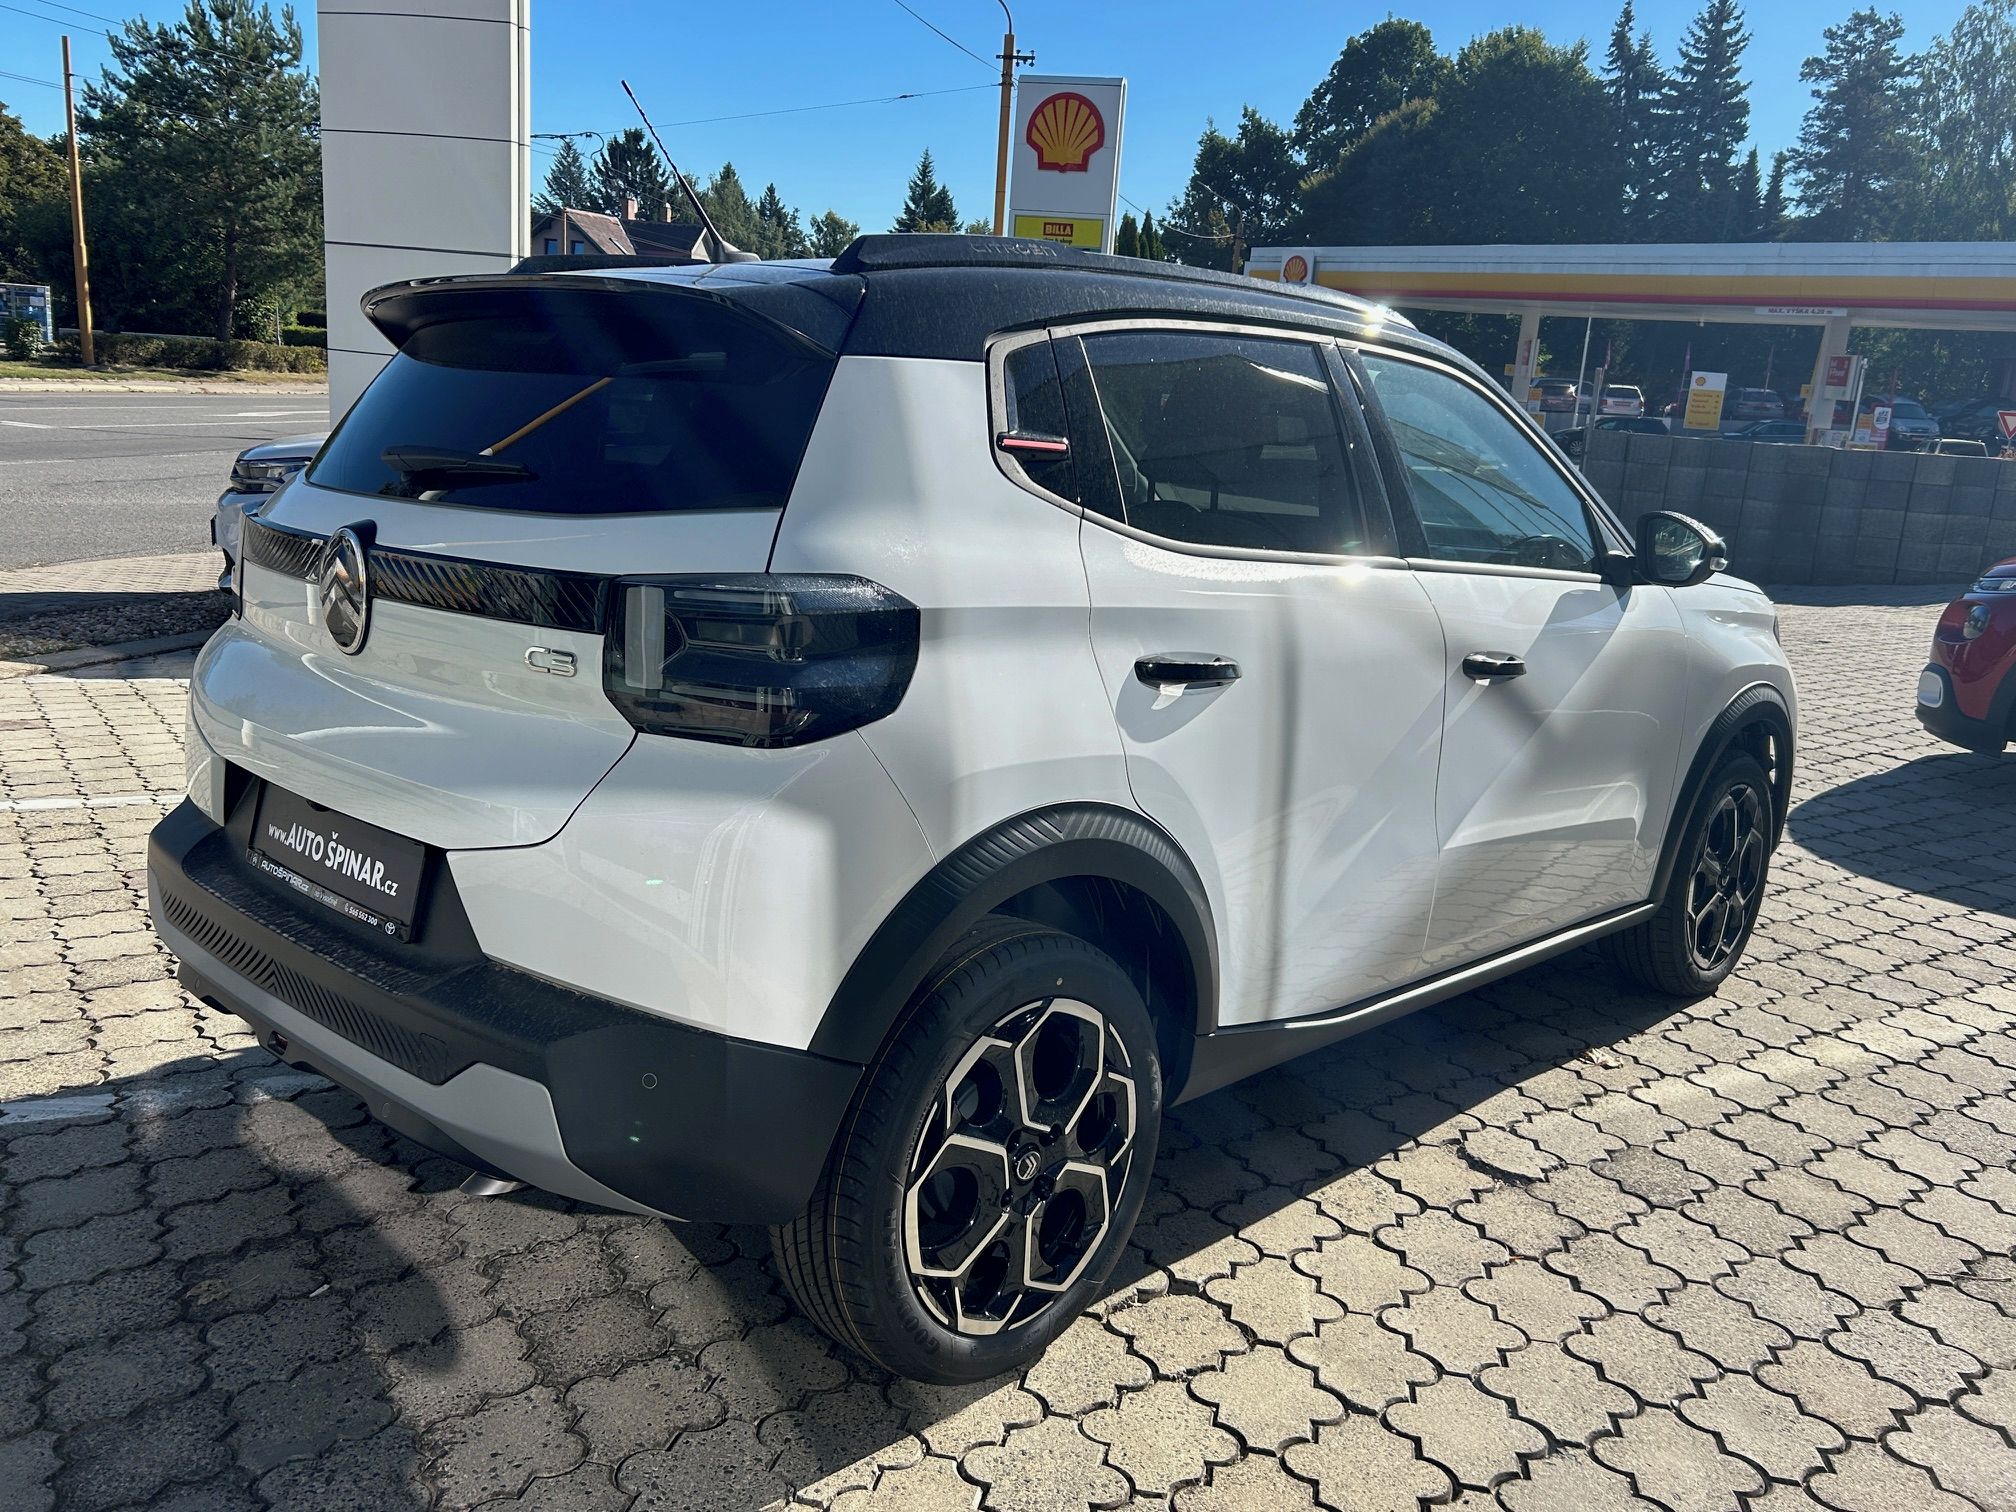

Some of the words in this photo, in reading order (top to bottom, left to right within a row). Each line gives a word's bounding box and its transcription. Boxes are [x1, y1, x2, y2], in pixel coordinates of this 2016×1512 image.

[1045, 224, 1072, 236] BILLA
[524, 645, 578, 678] C3
[268, 822, 324, 862] www.AUTO
[325, 831, 399, 897] ŠPINAR.cz
[367, 915, 378, 926] 300
